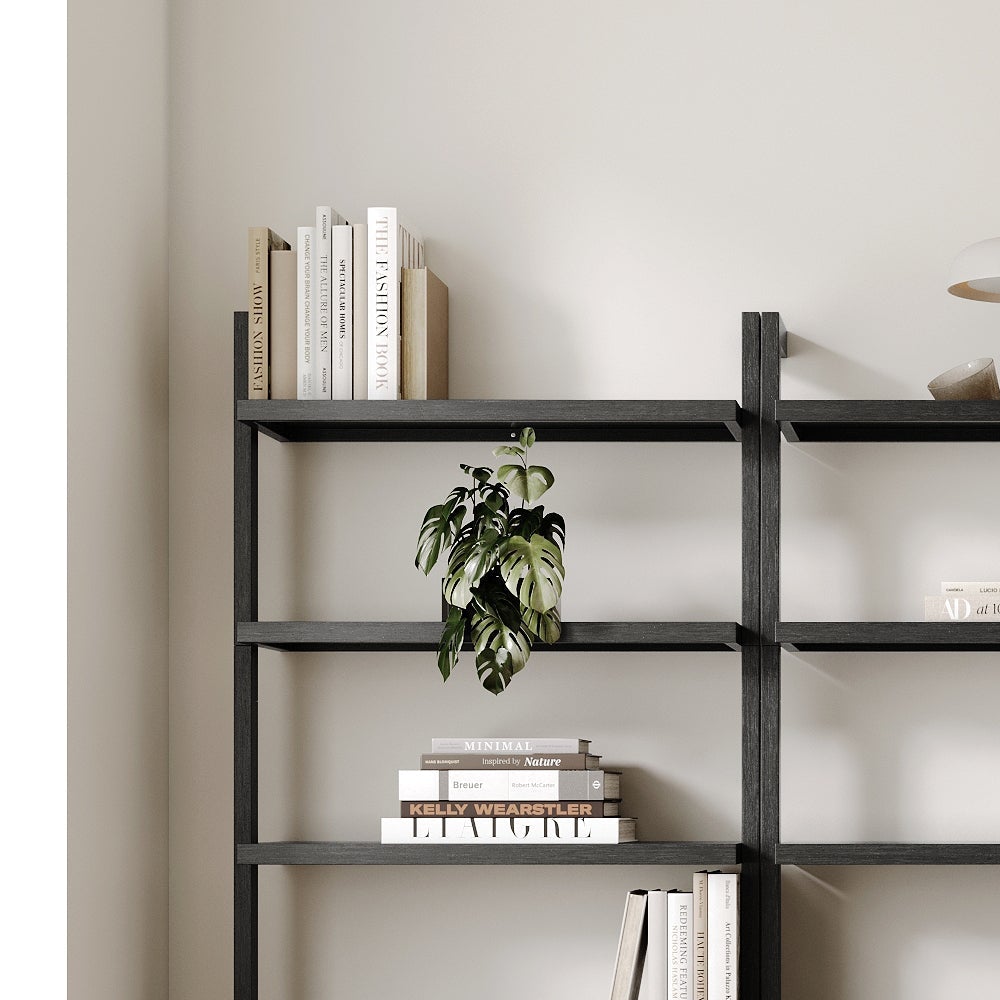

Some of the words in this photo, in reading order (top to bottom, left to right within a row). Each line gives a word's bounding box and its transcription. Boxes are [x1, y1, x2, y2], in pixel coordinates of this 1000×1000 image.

[376, 217, 389, 255] THE
[320, 255, 328, 274] THE
[253, 283, 264, 325] SHOW
[320, 276, 328, 314] ALLURE
[376, 260, 389, 337] FASHION
[320, 315, 328, 328] OF
[320, 330, 328, 353] MEN
[253, 331, 264, 392] FASHION
[376, 344, 389, 390] BOOK
[942, 598, 971, 620] AD
[976, 604, 988, 615] at
[464, 741, 533, 751] MINIMAL
[482, 757, 511, 767] Inspired
[512, 757, 521, 767] by
[523, 756, 562, 767] Nature
[453, 781, 483, 790] Breuer
[409, 803, 468, 816] KELLY
[474, 803, 593, 816] WEARSTLER
[680, 904, 688, 964] REDEEMING
[697, 932, 705, 966] HAUTE
